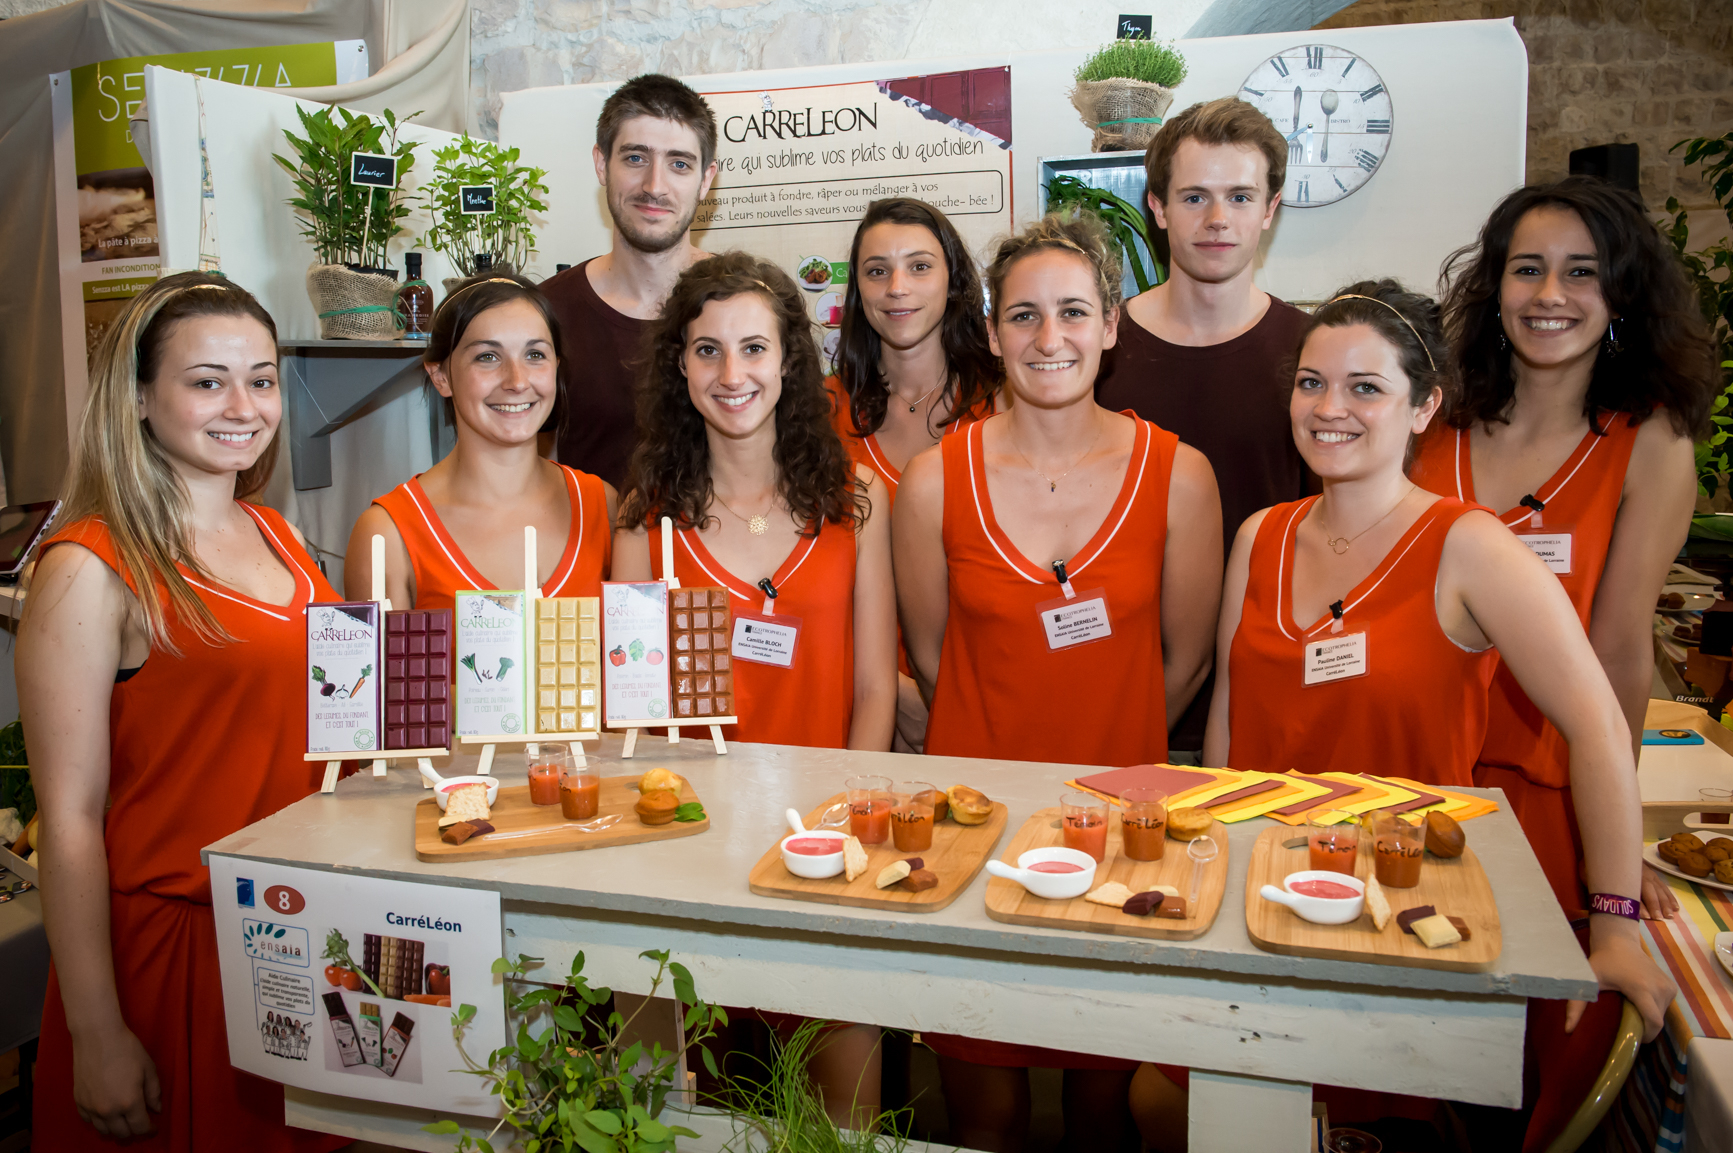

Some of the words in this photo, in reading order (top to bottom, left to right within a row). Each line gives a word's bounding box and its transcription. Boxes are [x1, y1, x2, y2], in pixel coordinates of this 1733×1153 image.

[98, 62, 292, 122] SEZZA
[741, 152, 761, 175] qui
[766, 148, 816, 169] sublime
[822, 150, 845, 165] vos
[852, 142, 886, 166] plats
[892, 141, 909, 159] du
[916, 137, 983, 162] quotidien
[732, 192, 767, 207] produit
[770, 191, 775, 202] à
[778, 189, 814, 201] fondre,
[817, 188, 842, 199] râper
[862, 183, 909, 197] mélanger
[912, 183, 917, 192] à
[921, 183, 939, 191] vos
[696, 211, 726, 222] salées.
[729, 211, 753, 221] Leurs
[756, 205, 802, 218] nouvelles
[805, 206, 840, 216] saveurs
[842, 204, 866, 214] vous
[969, 195, 987, 206] bée
[98, 239, 106, 247] La
[107, 238, 123, 249] pâte
[124, 237, 128, 245] à
[130, 235, 151, 246] pizza
[122, 284, 130, 292] LA
[279, 891, 290, 910] 8
[1592, 895, 1634, 914] SOLIDAYS
[386, 912, 462, 932] CarréLéon
[261, 941, 301, 956] ensaia
